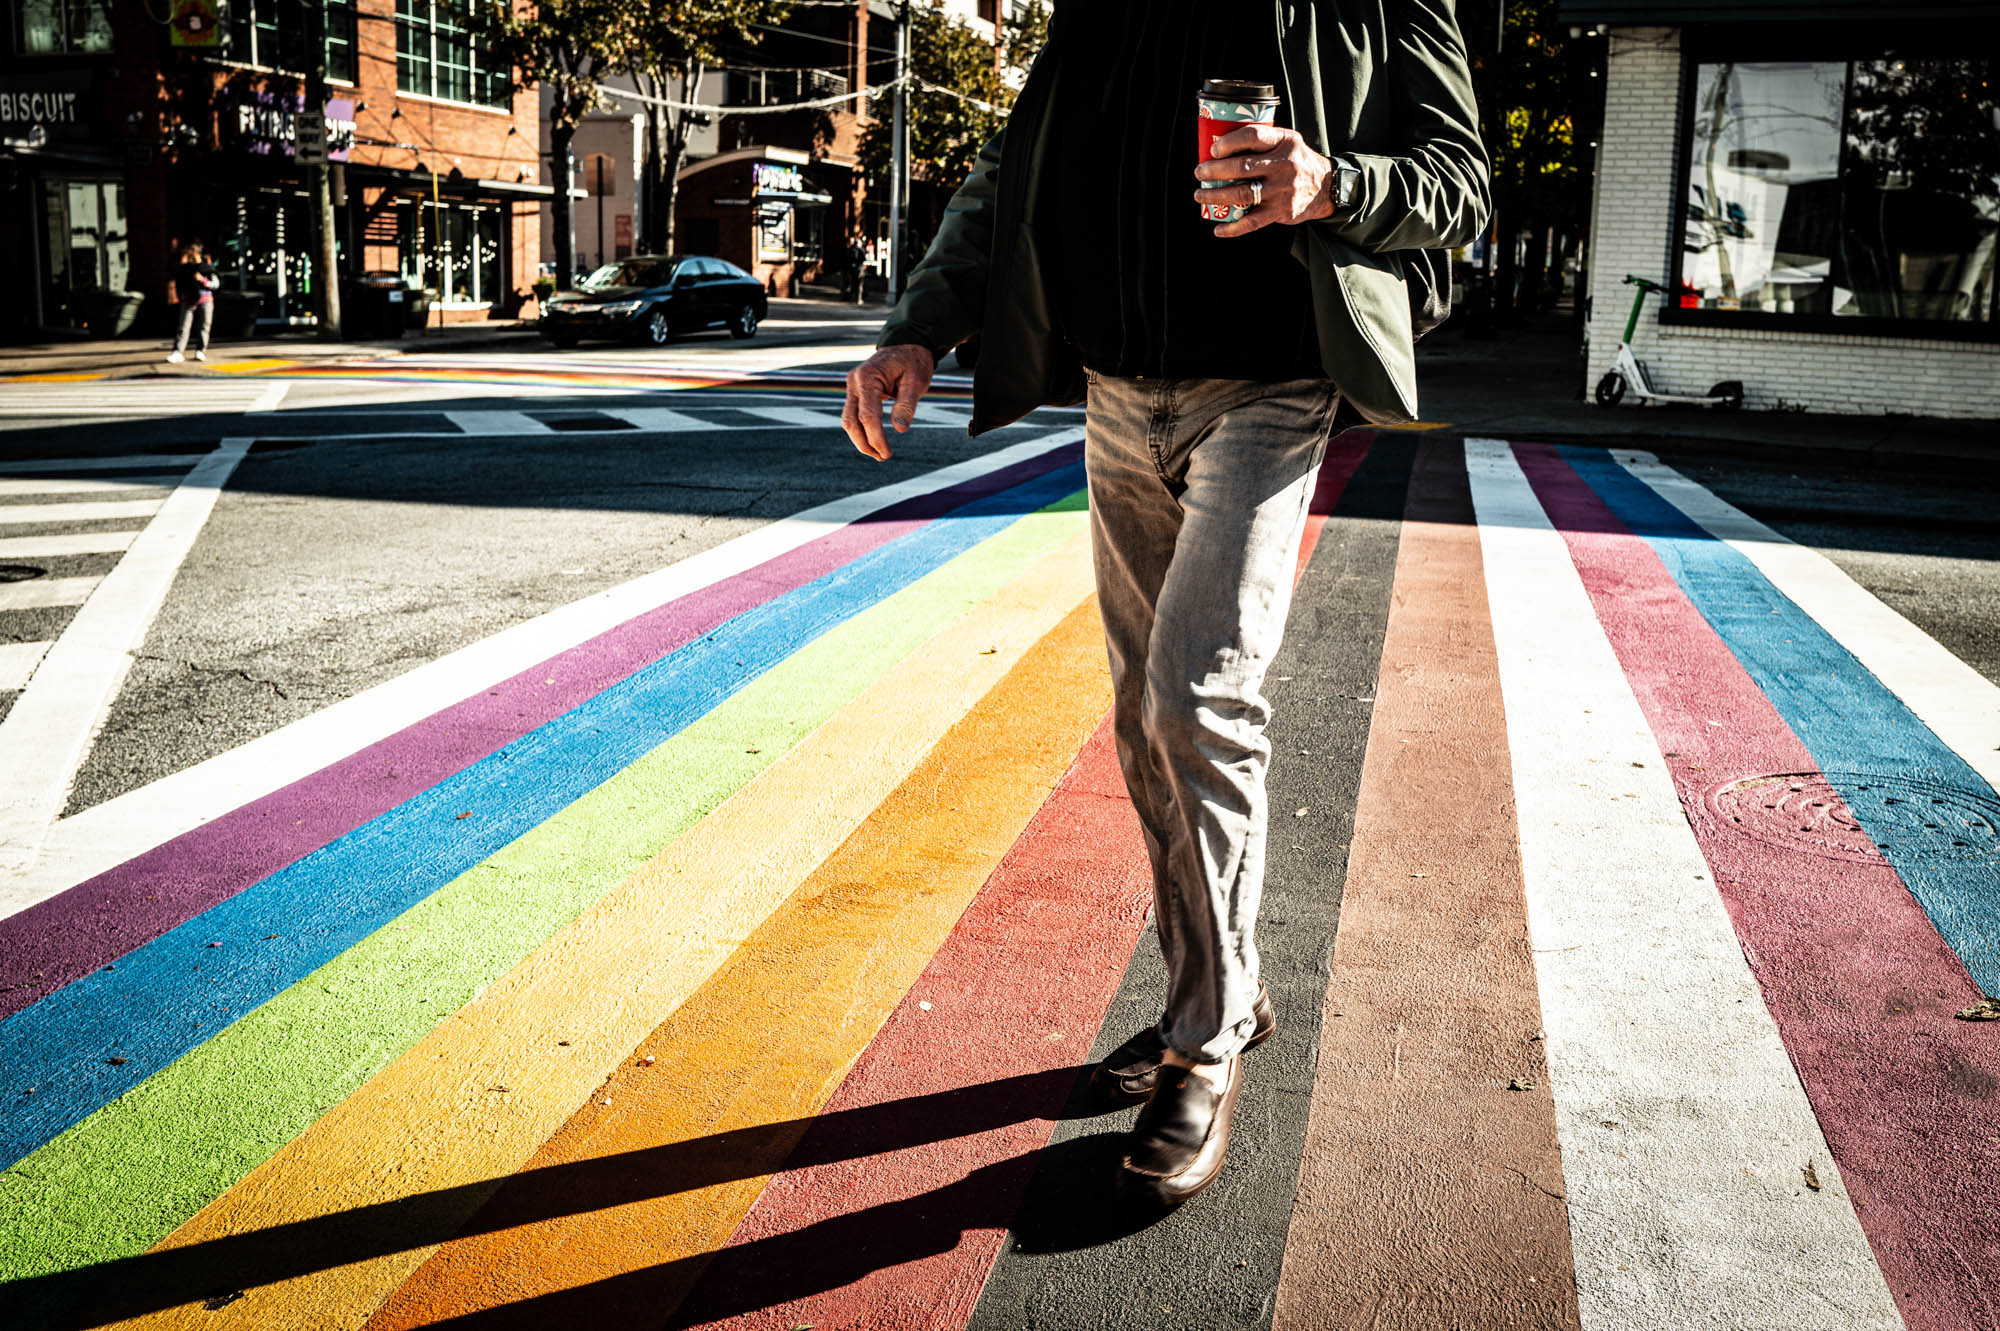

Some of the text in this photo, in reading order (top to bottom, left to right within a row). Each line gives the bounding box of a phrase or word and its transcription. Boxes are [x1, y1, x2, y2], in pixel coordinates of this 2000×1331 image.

[0, 92, 76, 122] BISCUIT
[238, 104, 295, 141] FLYING
[298, 116, 320, 129] ONE
